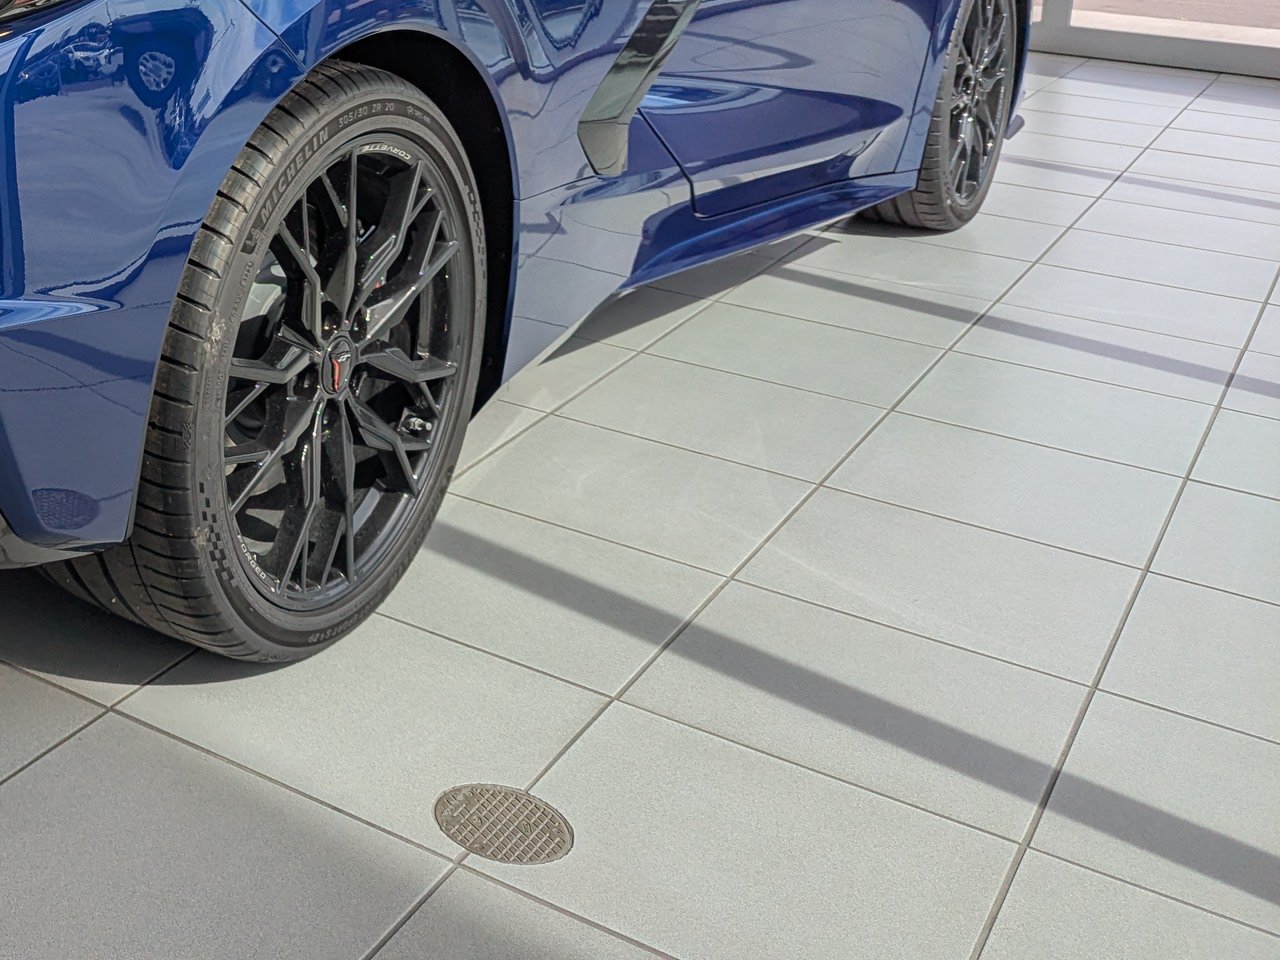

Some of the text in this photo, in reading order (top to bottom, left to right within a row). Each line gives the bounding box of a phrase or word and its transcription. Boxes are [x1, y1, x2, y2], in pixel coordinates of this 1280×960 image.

[260, 102, 395, 223] MICHELIN 305/30 ZR 20
[361, 143, 412, 161] CORVETTE
[236, 534, 268, 580] FORGED
